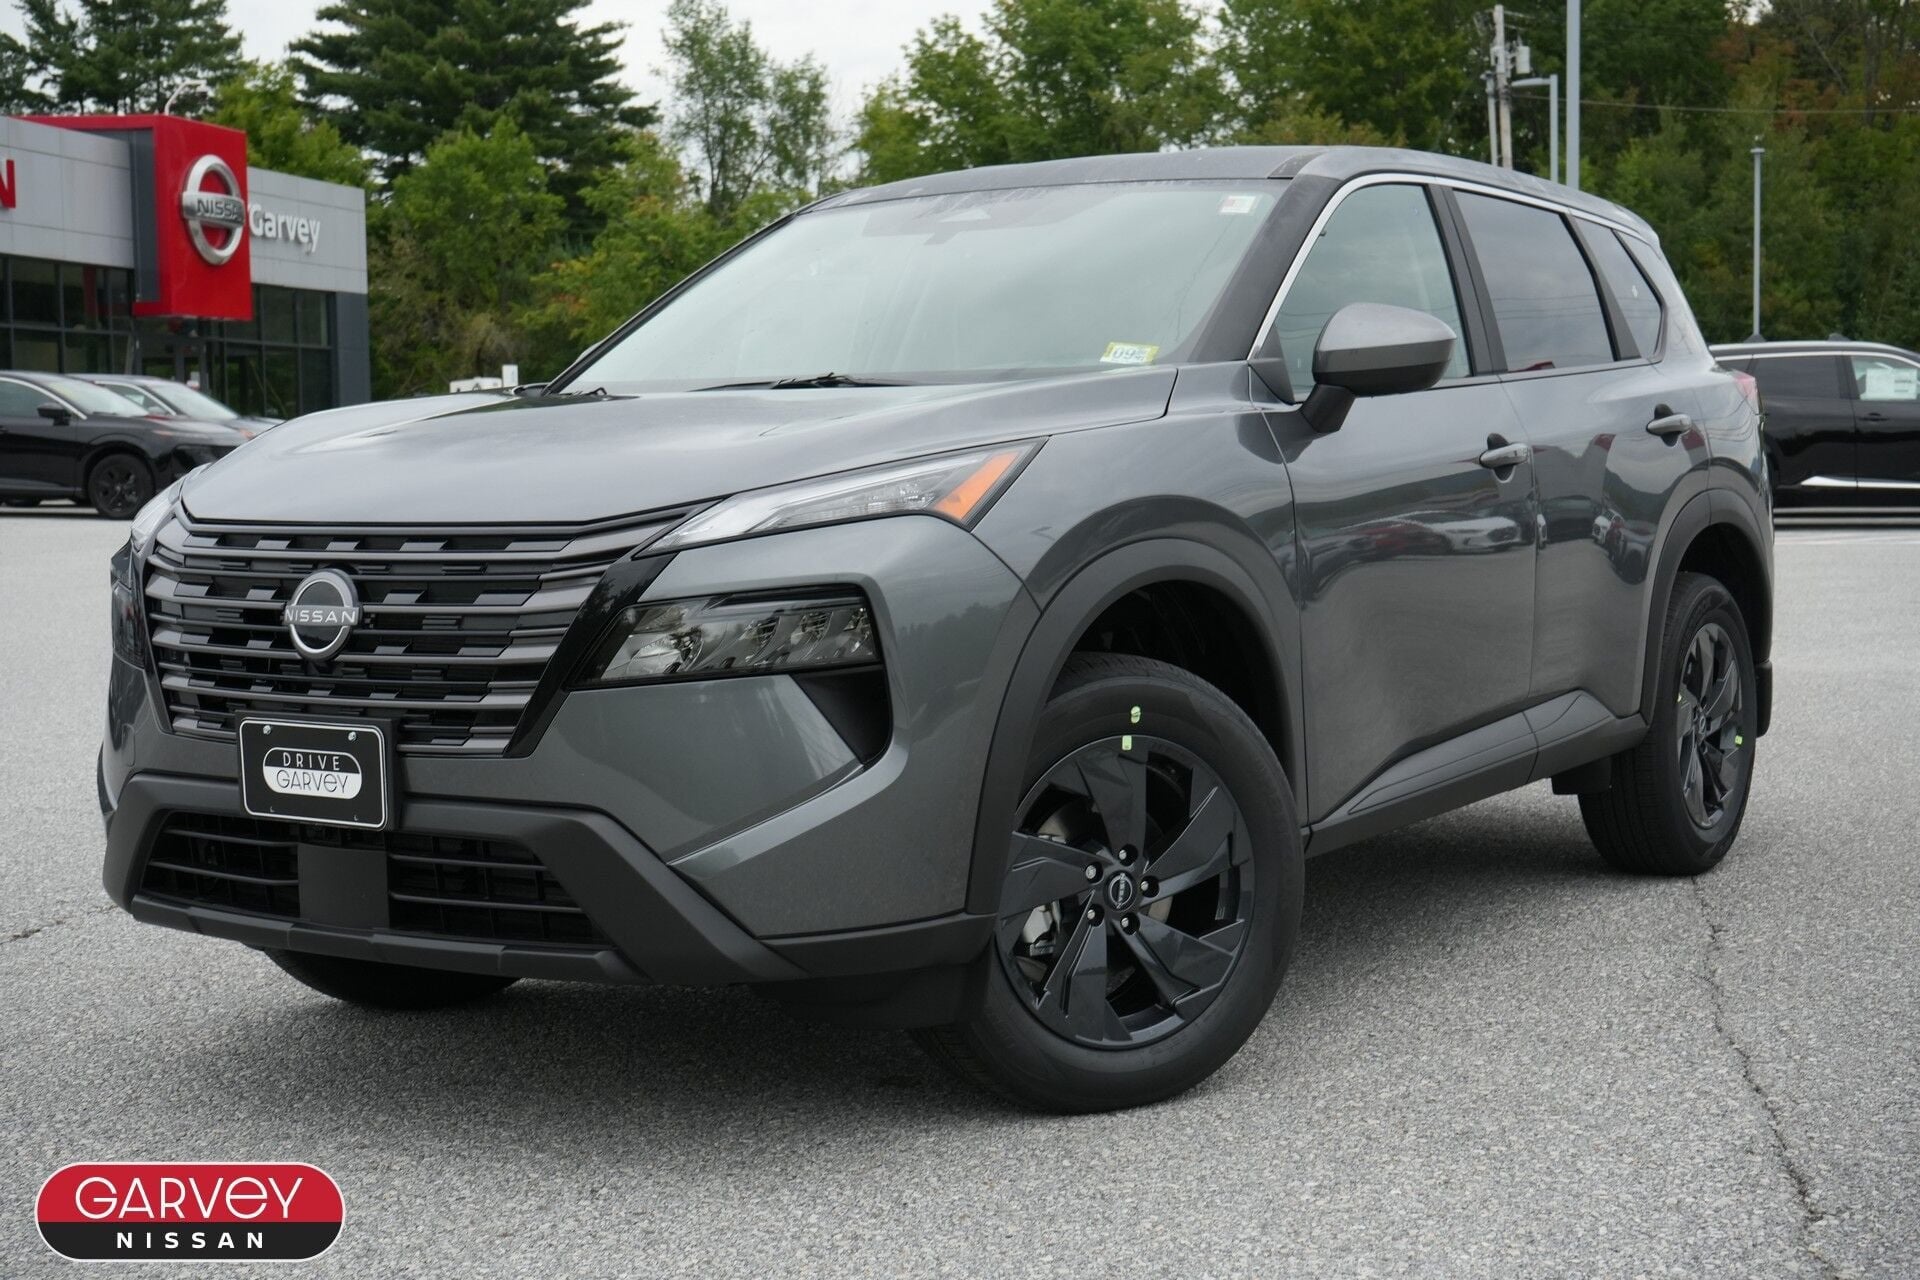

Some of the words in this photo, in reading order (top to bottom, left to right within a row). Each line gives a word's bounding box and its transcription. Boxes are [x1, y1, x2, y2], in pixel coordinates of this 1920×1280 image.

[196, 198, 243, 221] NISSA
[248, 203, 321, 254] Garvey
[284, 607, 357, 624] NISSAN
[282, 752, 341, 772] DRIVE
